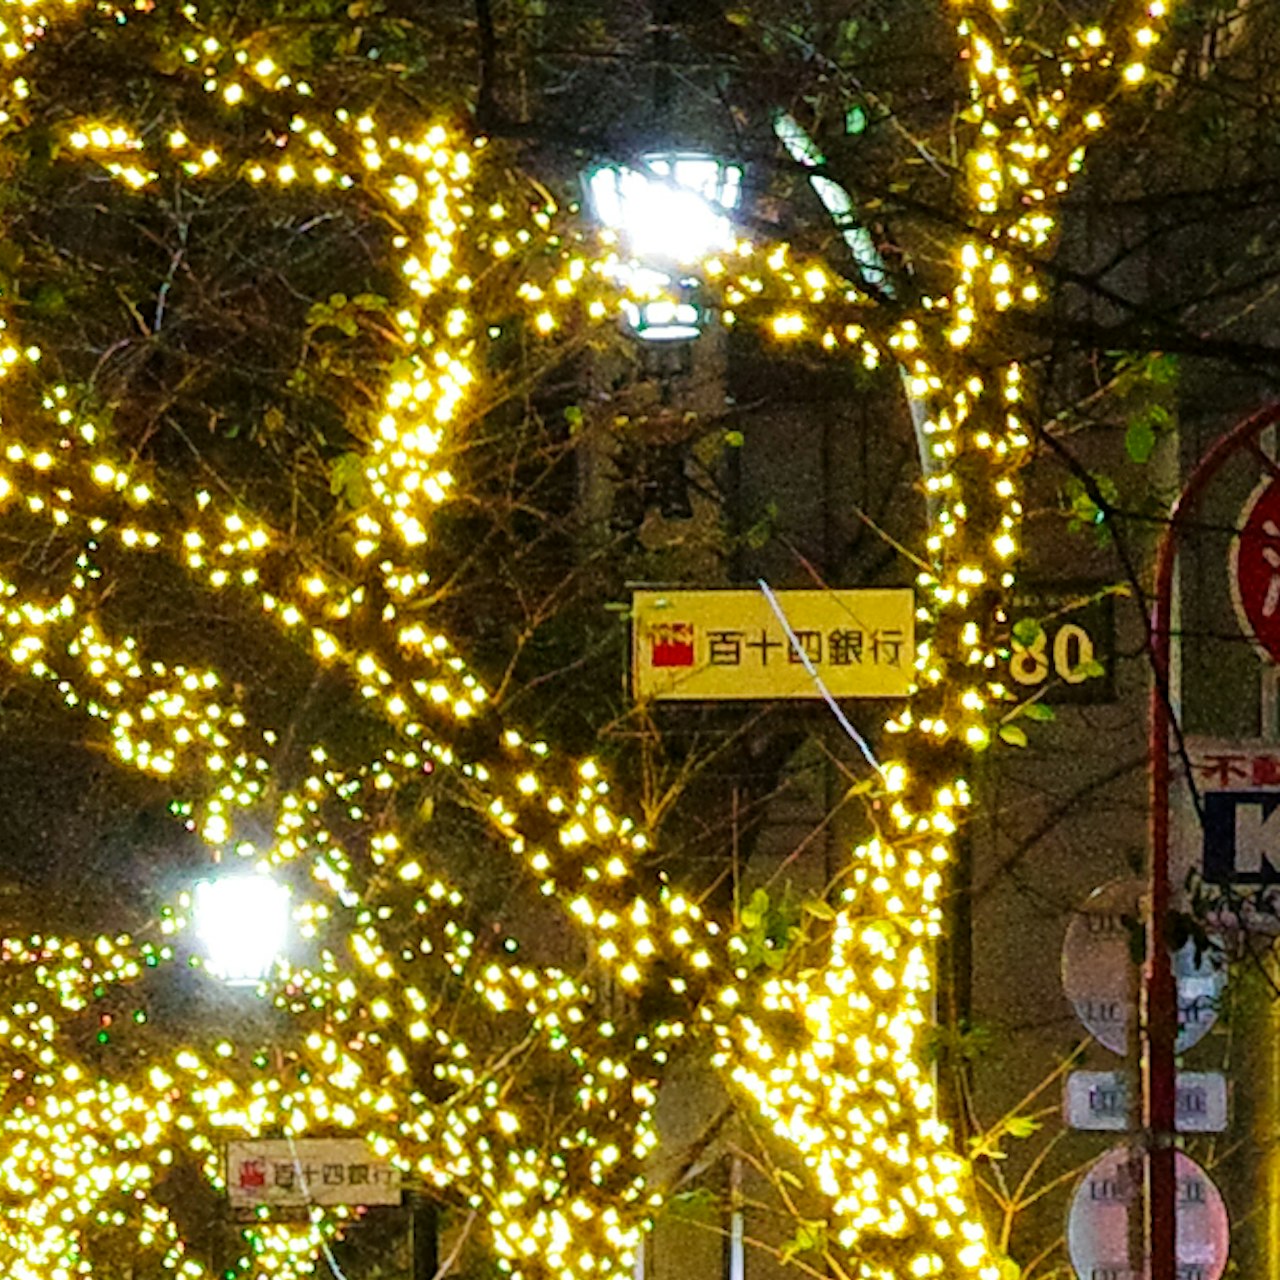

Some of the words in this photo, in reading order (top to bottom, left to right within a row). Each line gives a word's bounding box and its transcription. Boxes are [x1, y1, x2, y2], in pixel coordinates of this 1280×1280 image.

[706, 628, 904, 667] 百十四銀行
[1009, 620, 1094, 685] 80
[274, 1163, 393, 1188] 百十四銀行
